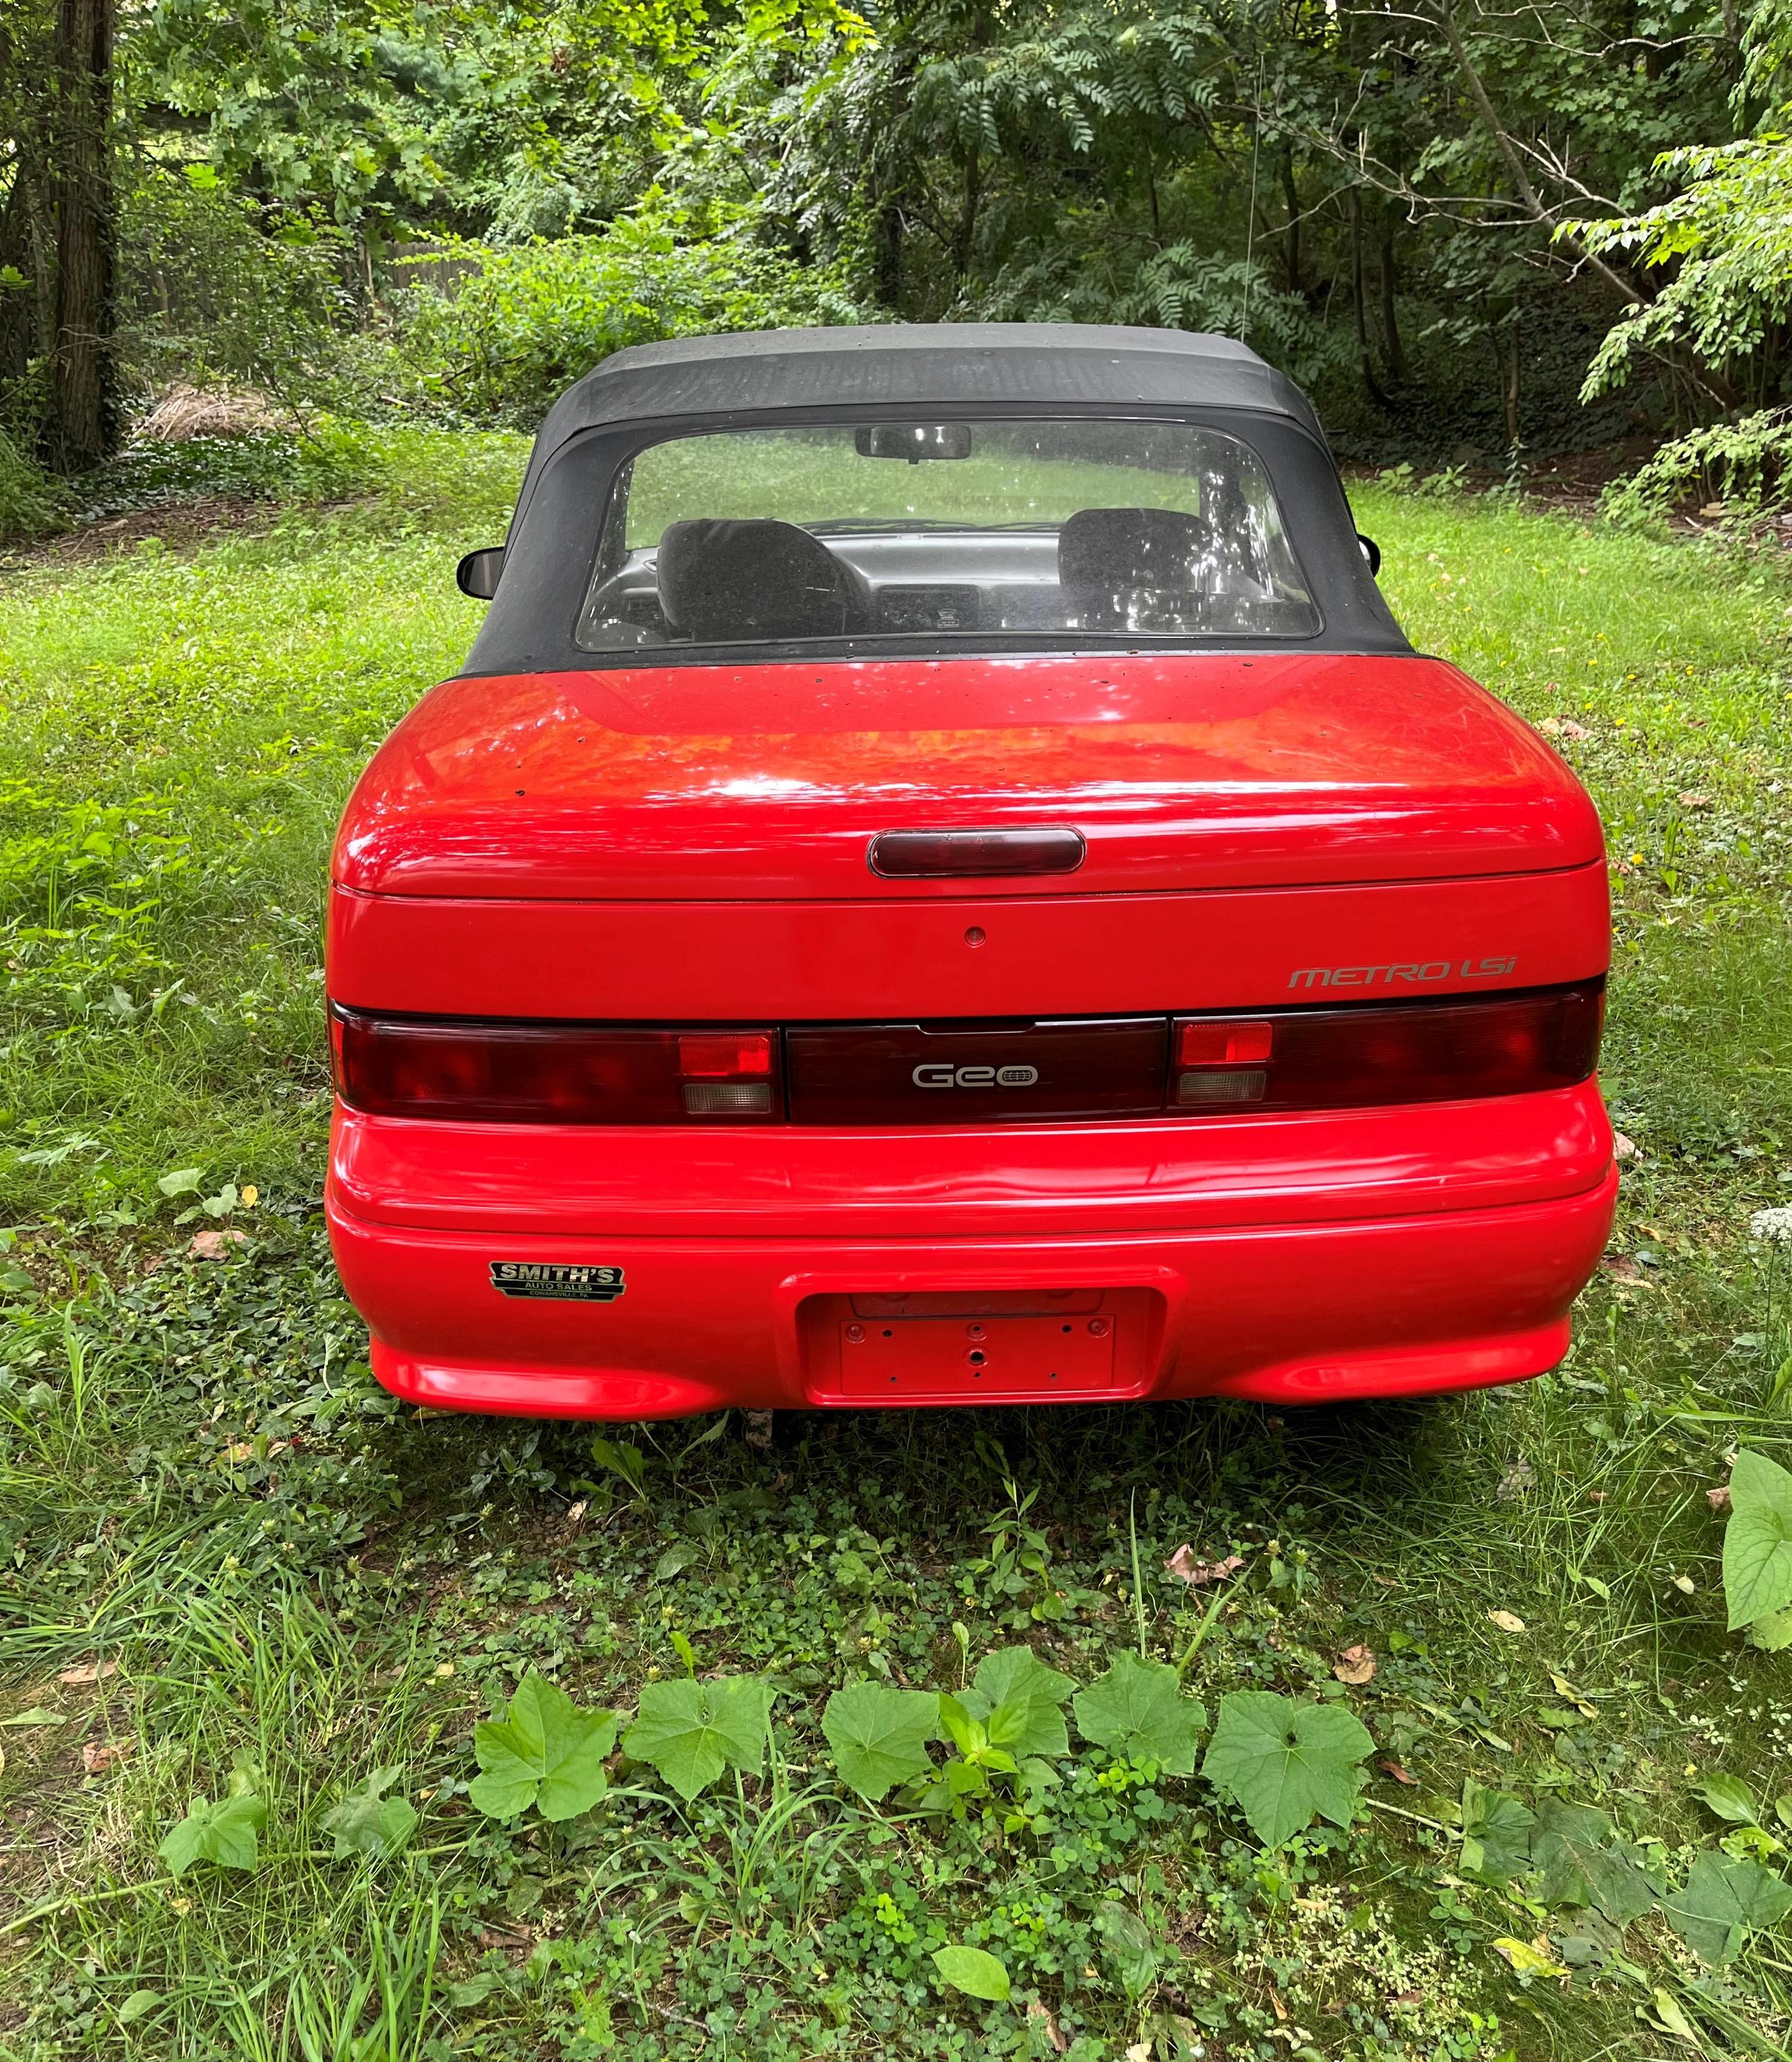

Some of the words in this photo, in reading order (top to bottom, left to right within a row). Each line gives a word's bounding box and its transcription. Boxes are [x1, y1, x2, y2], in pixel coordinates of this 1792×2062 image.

[1287, 962, 1450, 989] METRO
[1459, 956, 1517, 977] LSi
[912, 1064, 1038, 1088] Geo
[500, 1264, 615, 1283] SMITH'S
